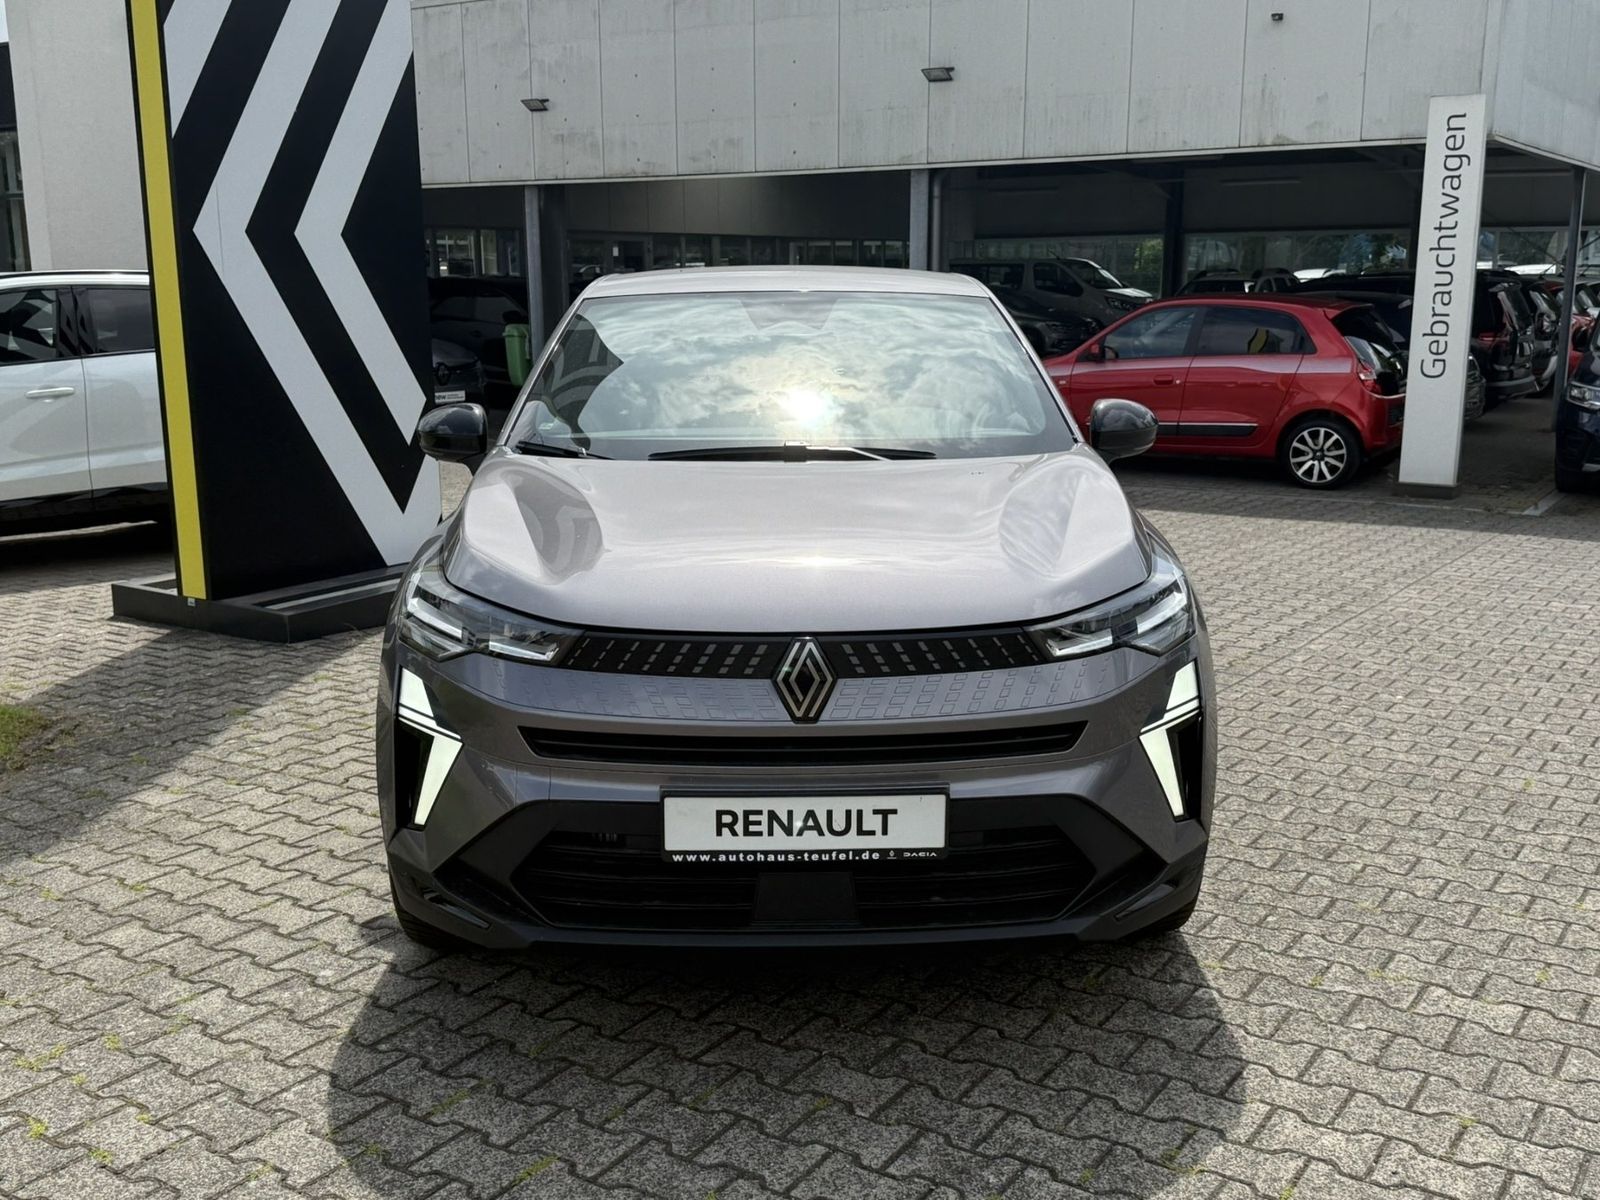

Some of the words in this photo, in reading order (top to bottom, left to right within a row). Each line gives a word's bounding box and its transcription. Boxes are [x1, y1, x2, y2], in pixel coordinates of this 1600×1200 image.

[1420, 112, 1470, 379] Gebrauchtwagen
[715, 809, 898, 837] RENAULT
[671, 850, 880, 862] www.autohaus-teufel.de
